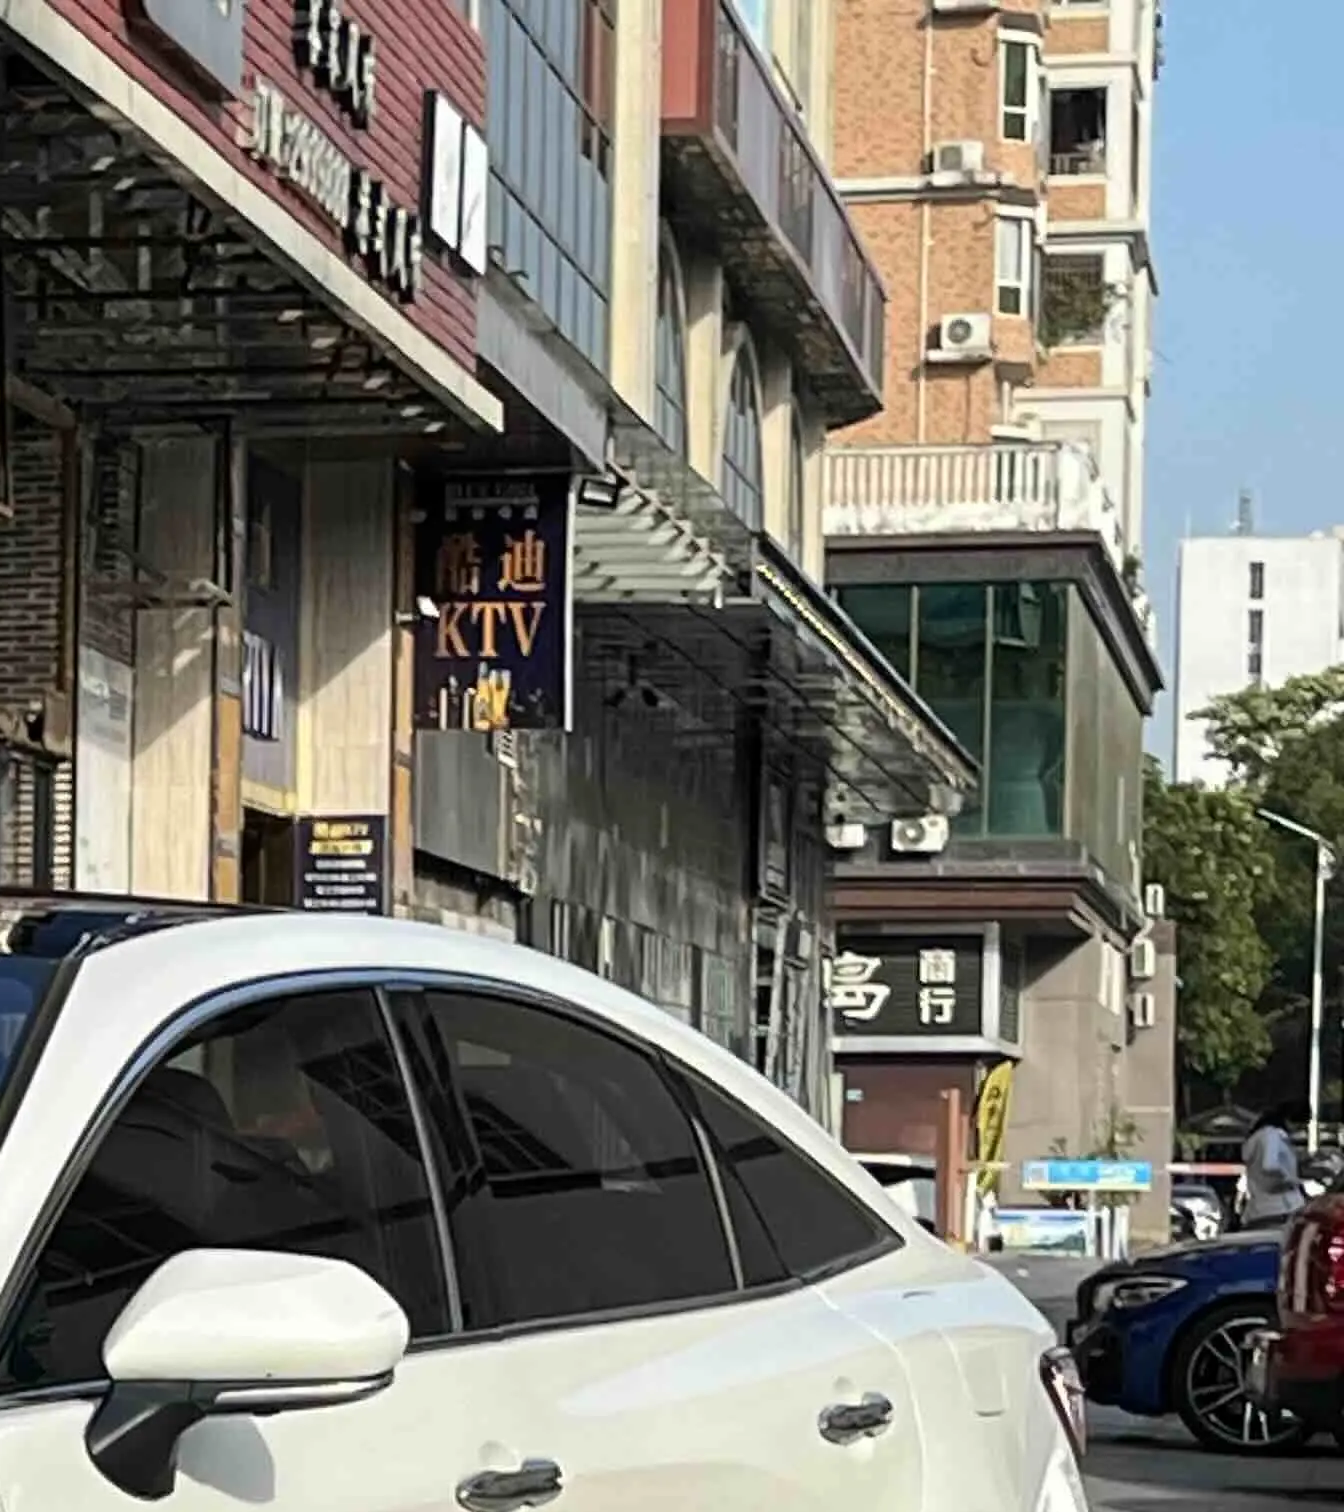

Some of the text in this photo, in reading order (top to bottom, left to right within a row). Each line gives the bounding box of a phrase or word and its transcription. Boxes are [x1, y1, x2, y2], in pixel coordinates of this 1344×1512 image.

[436, 529, 546, 595] 酷迪
[434, 601, 547, 658] KTV
[919, 949, 956, 1024] 商行
